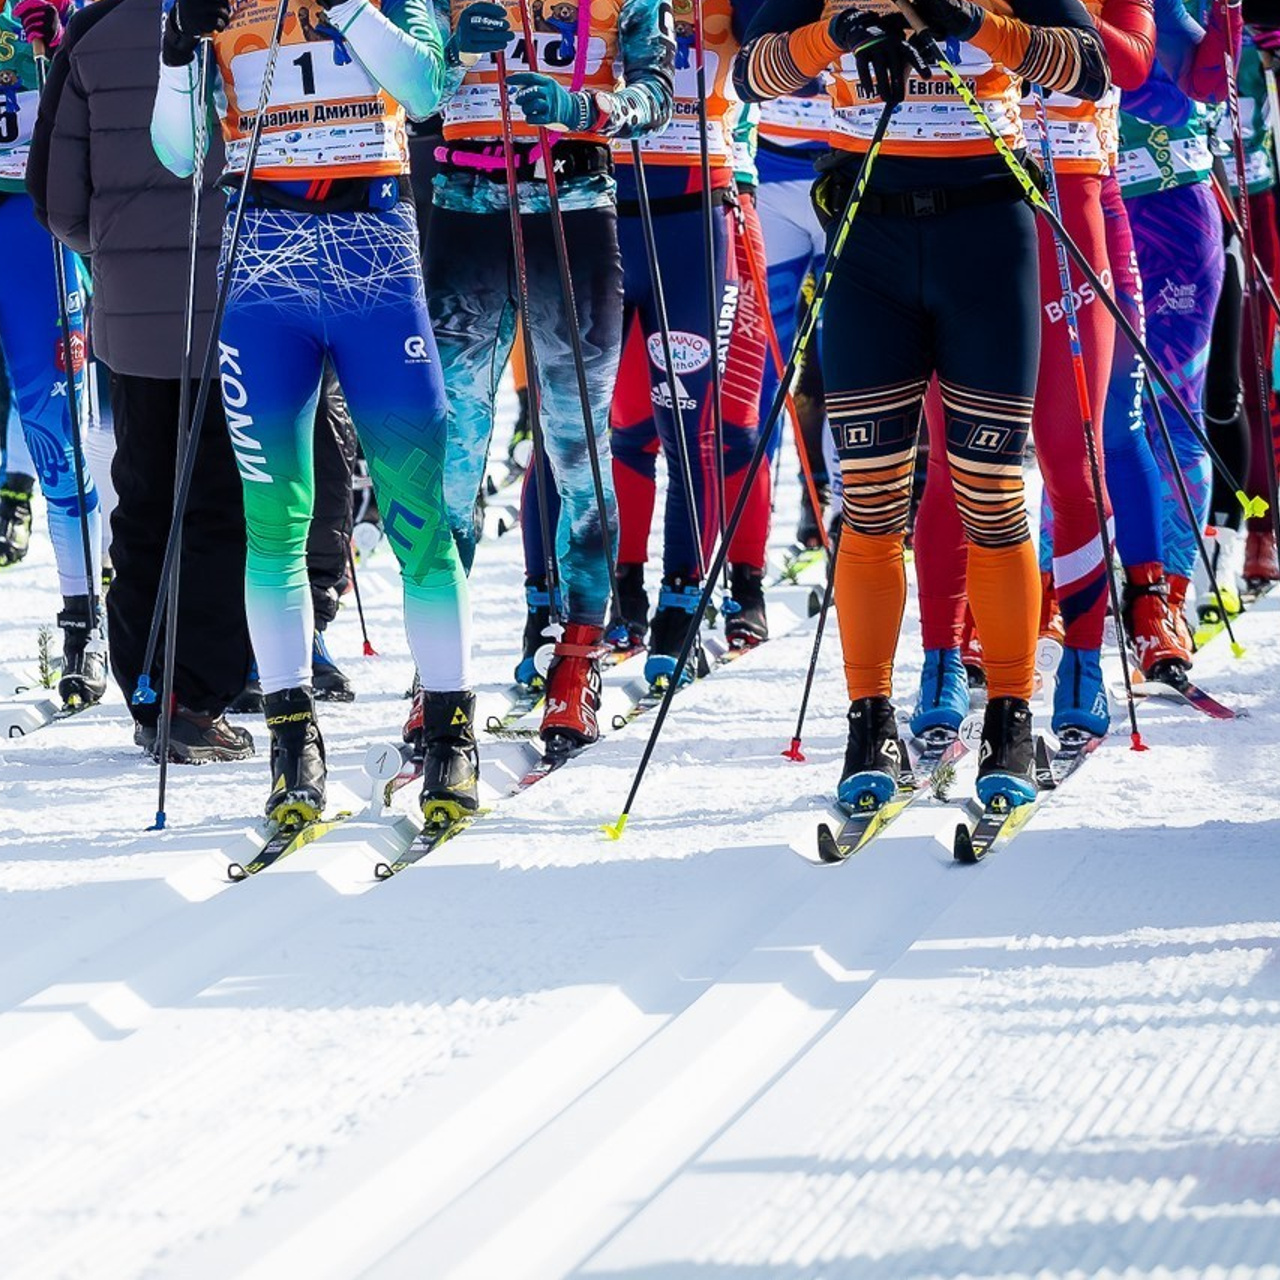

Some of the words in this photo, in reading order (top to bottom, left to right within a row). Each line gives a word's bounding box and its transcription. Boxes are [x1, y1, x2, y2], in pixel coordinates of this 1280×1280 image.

[293, 51, 316, 95] 1
[1045, 269, 1112, 323] BOSO
[716, 285, 738, 374] SATURN
[267, 711, 312, 725] SCHER
